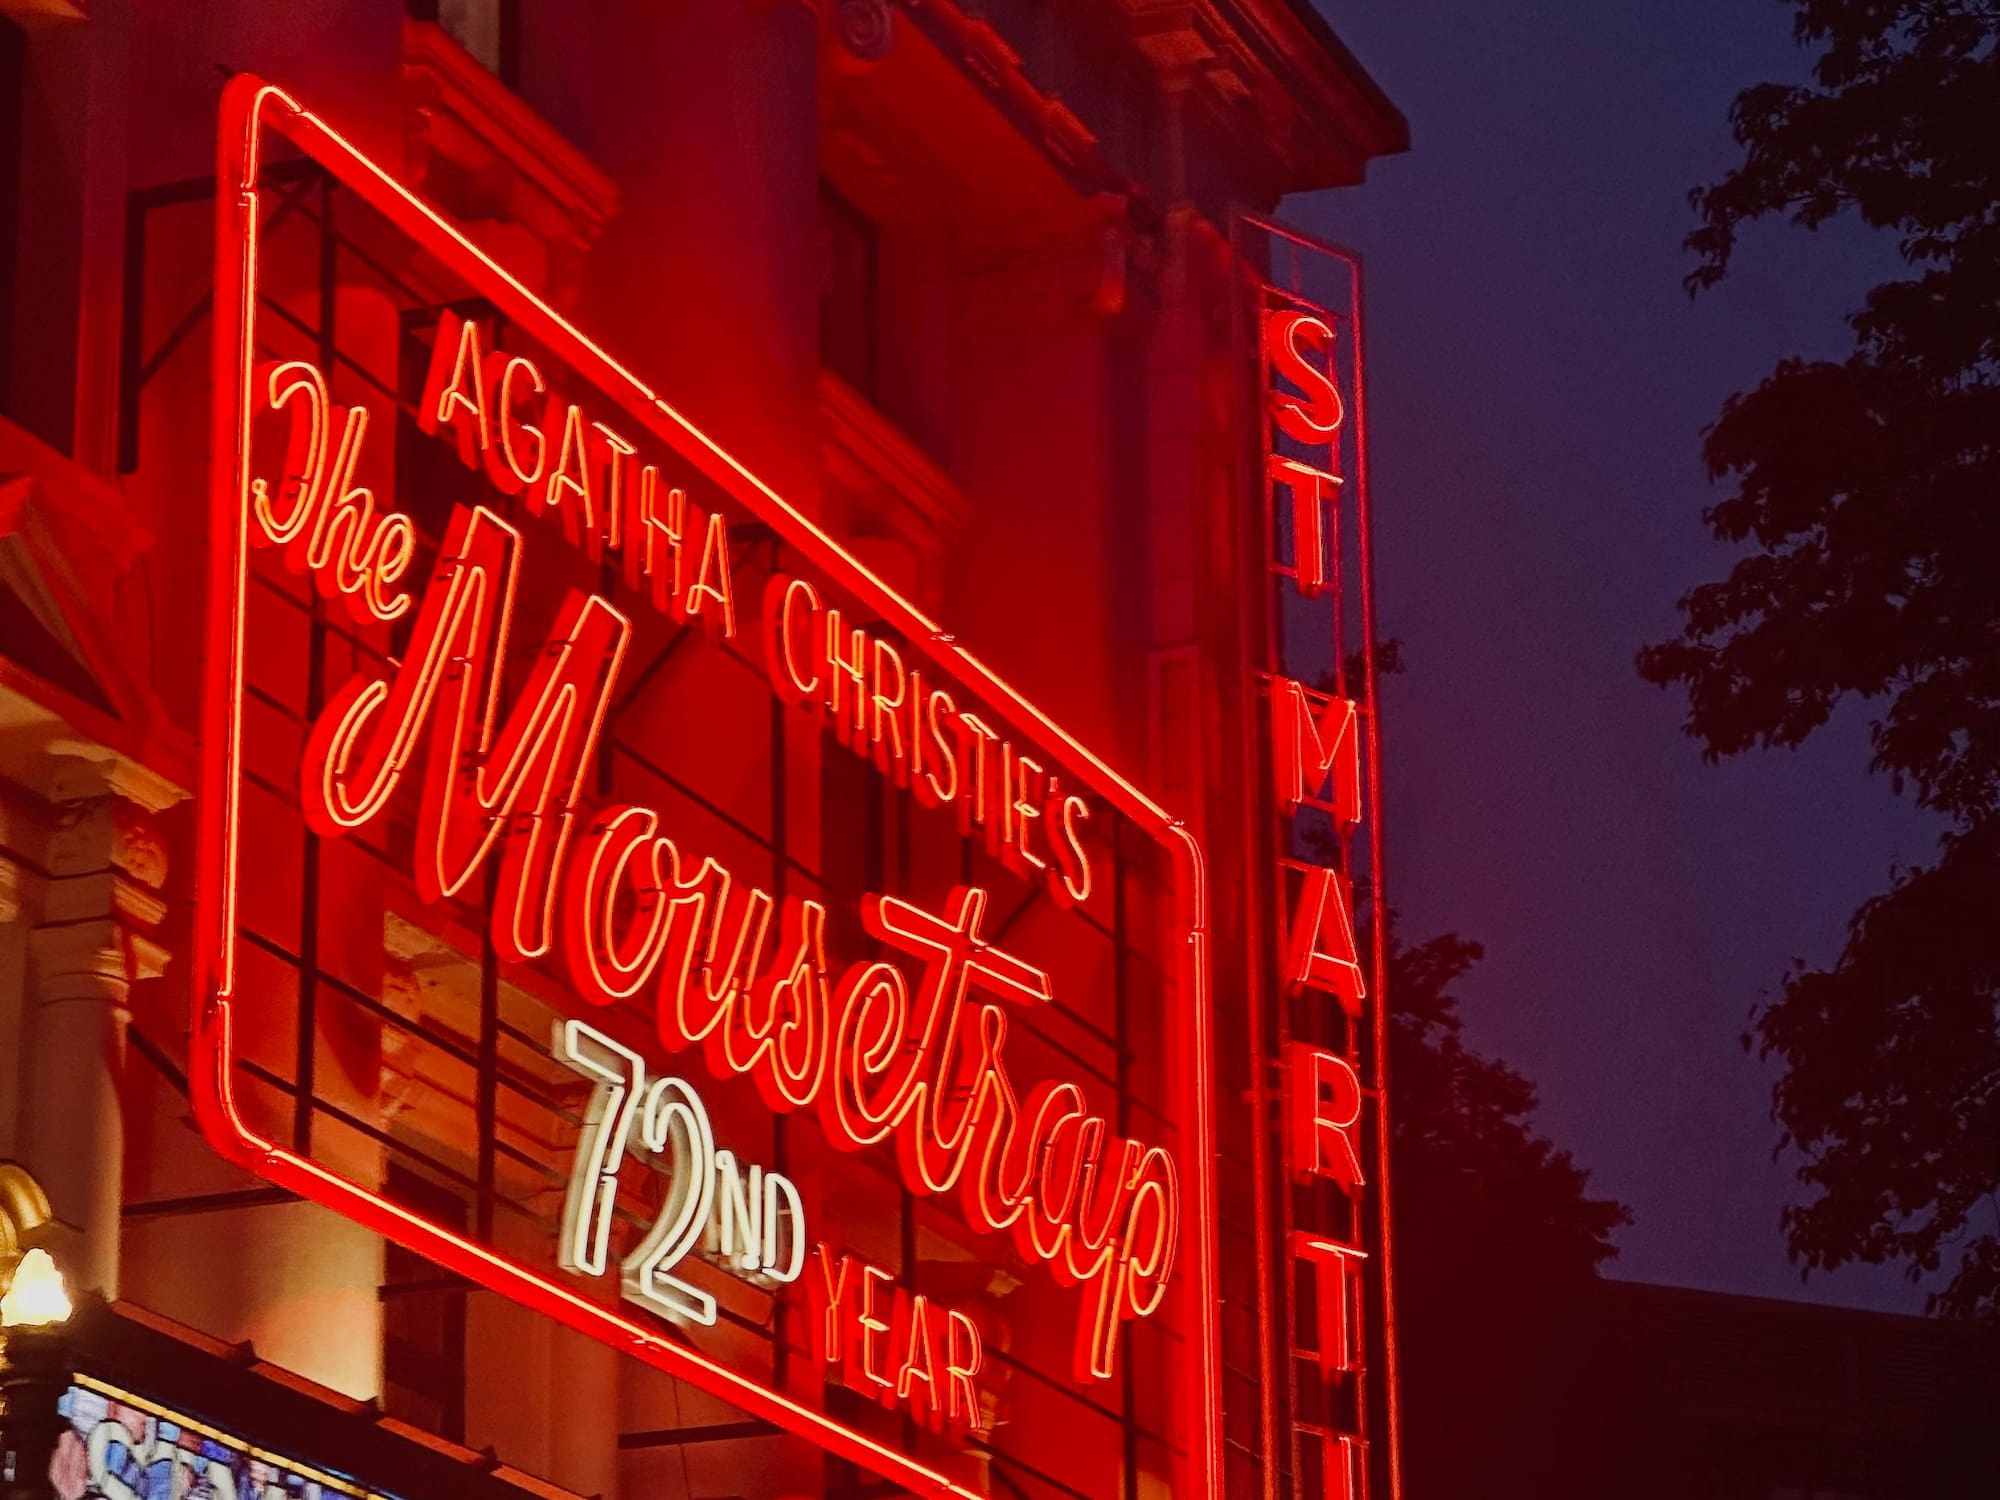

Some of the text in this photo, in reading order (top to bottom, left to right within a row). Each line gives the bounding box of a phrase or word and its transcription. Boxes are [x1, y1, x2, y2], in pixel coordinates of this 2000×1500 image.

[251, 360, 415, 620] The
[434, 318, 1092, 902] AGATHA CHRISTIE'S
[1270, 310, 1344, 590] ST
[322, 504, 1178, 1380] Mousetrap
[562, 1018, 982, 1428] 72ND YEAR
